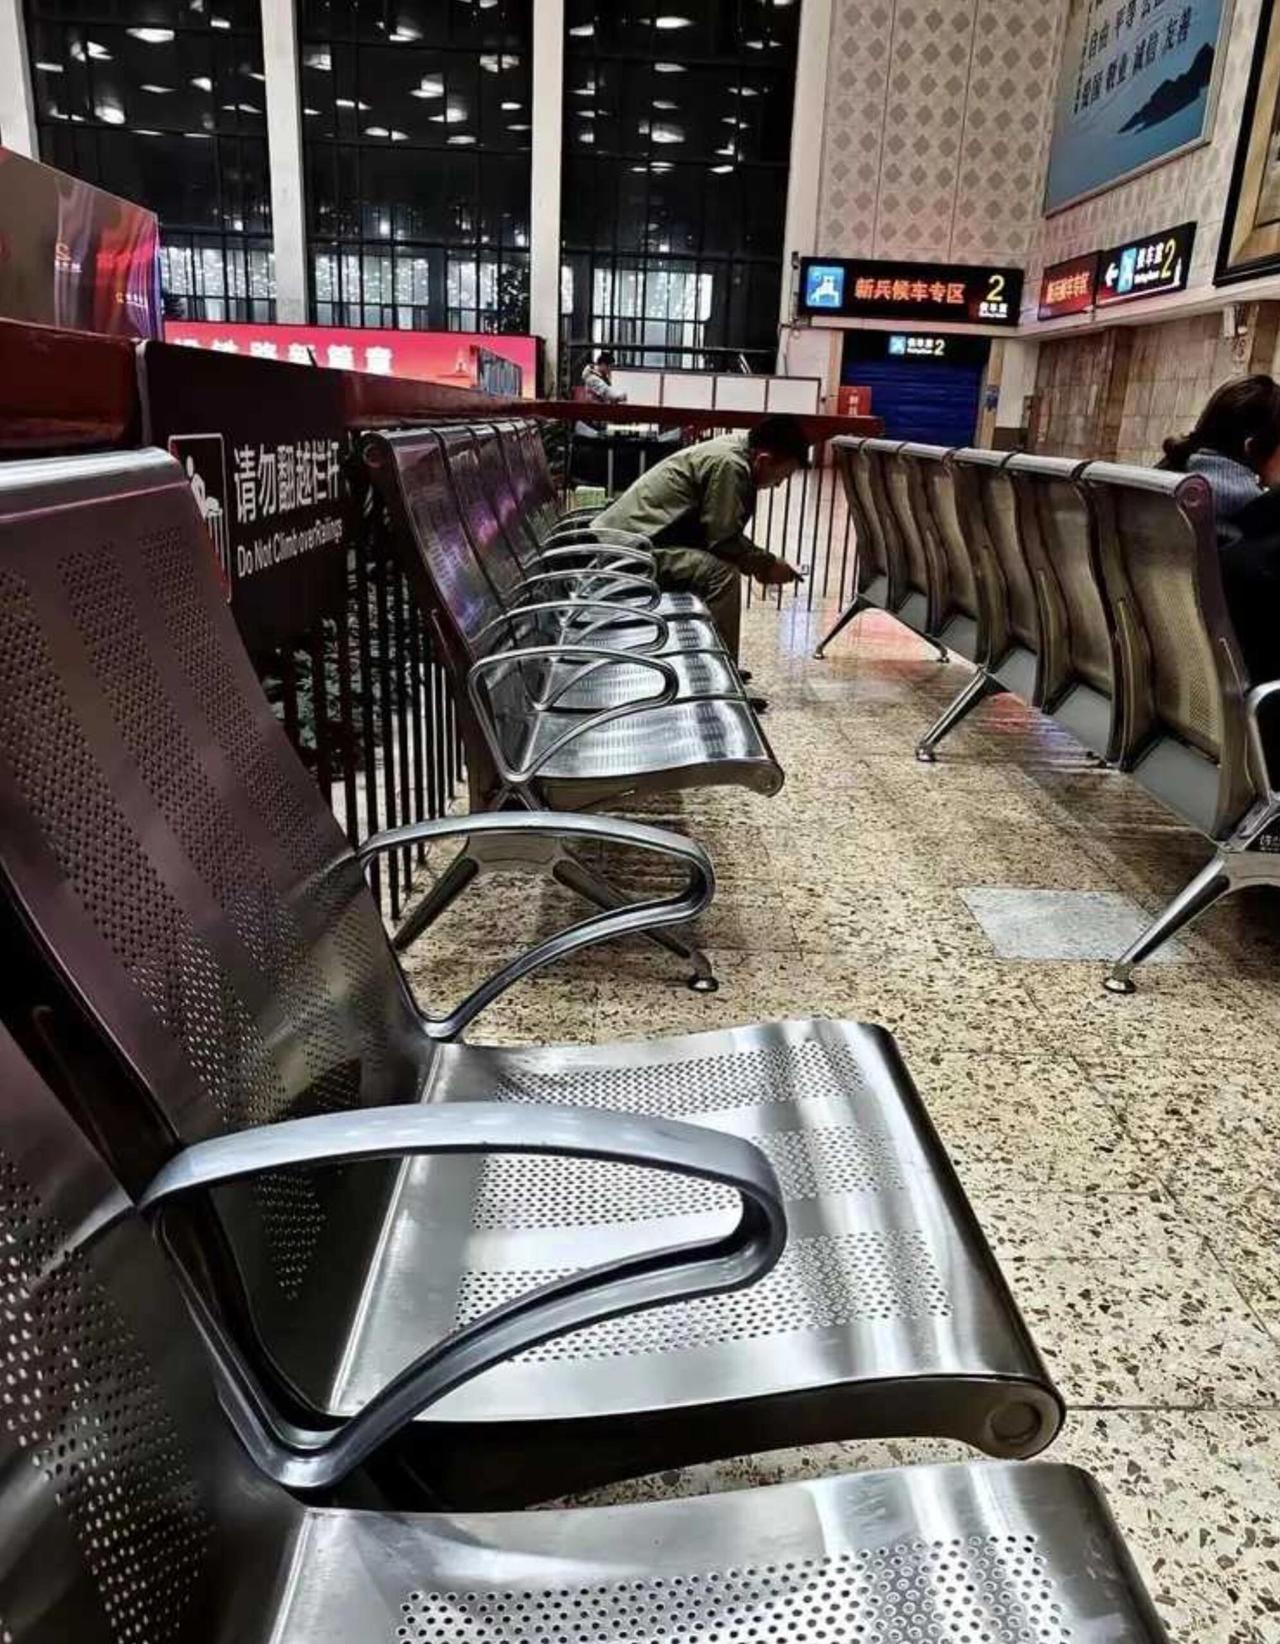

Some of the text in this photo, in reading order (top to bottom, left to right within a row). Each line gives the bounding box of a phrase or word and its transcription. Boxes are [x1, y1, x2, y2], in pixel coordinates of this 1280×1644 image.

[1160, 238, 1177, 279] 2
[854, 277, 967, 304] 新兵候车专区
[986, 274, 1006, 301] 2
[933, 339, 945, 356] 2
[233, 437, 341, 525] 请勿翻越栏杆
[237, 544, 254, 578] Do
[254, 537, 273, 572] Not
